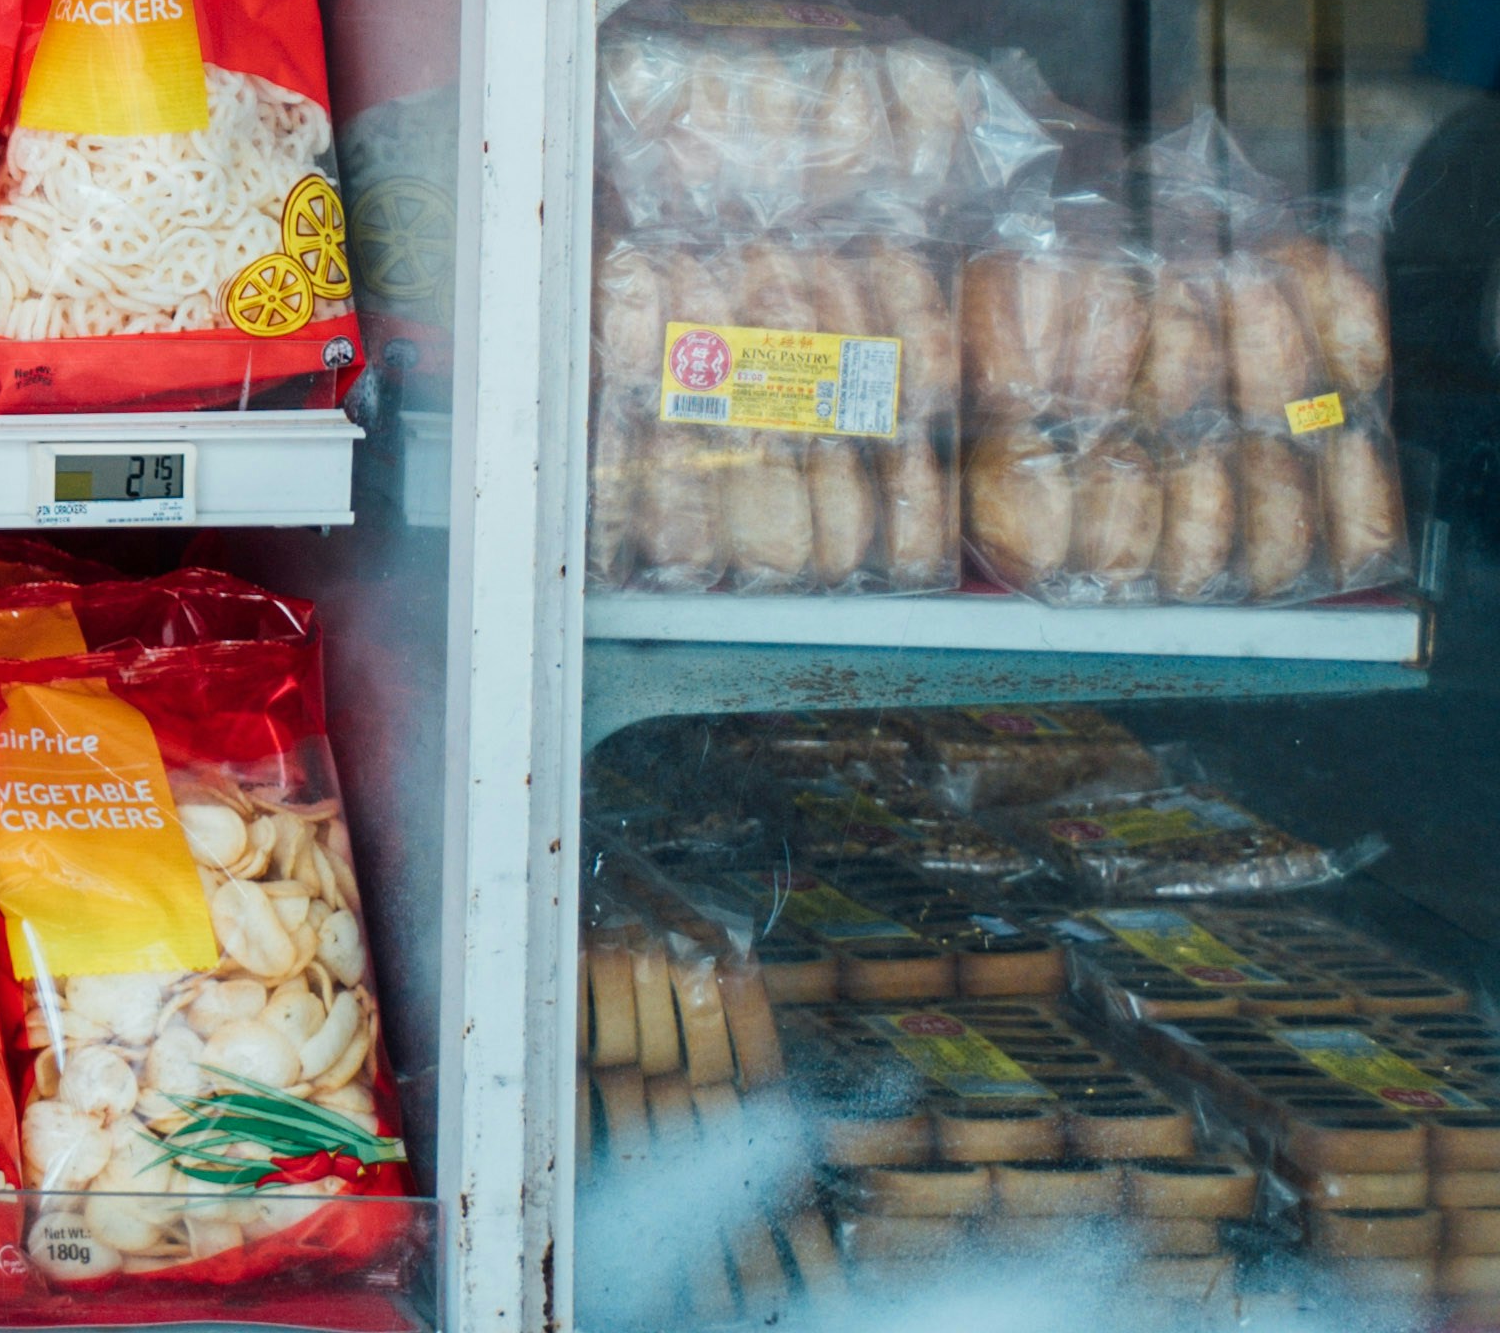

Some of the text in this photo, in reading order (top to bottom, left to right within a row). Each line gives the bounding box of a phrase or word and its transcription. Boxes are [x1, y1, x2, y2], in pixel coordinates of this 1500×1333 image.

[741, 347, 831, 365] KING PASTRY
[0, 804, 165, 832] CRACKERS
